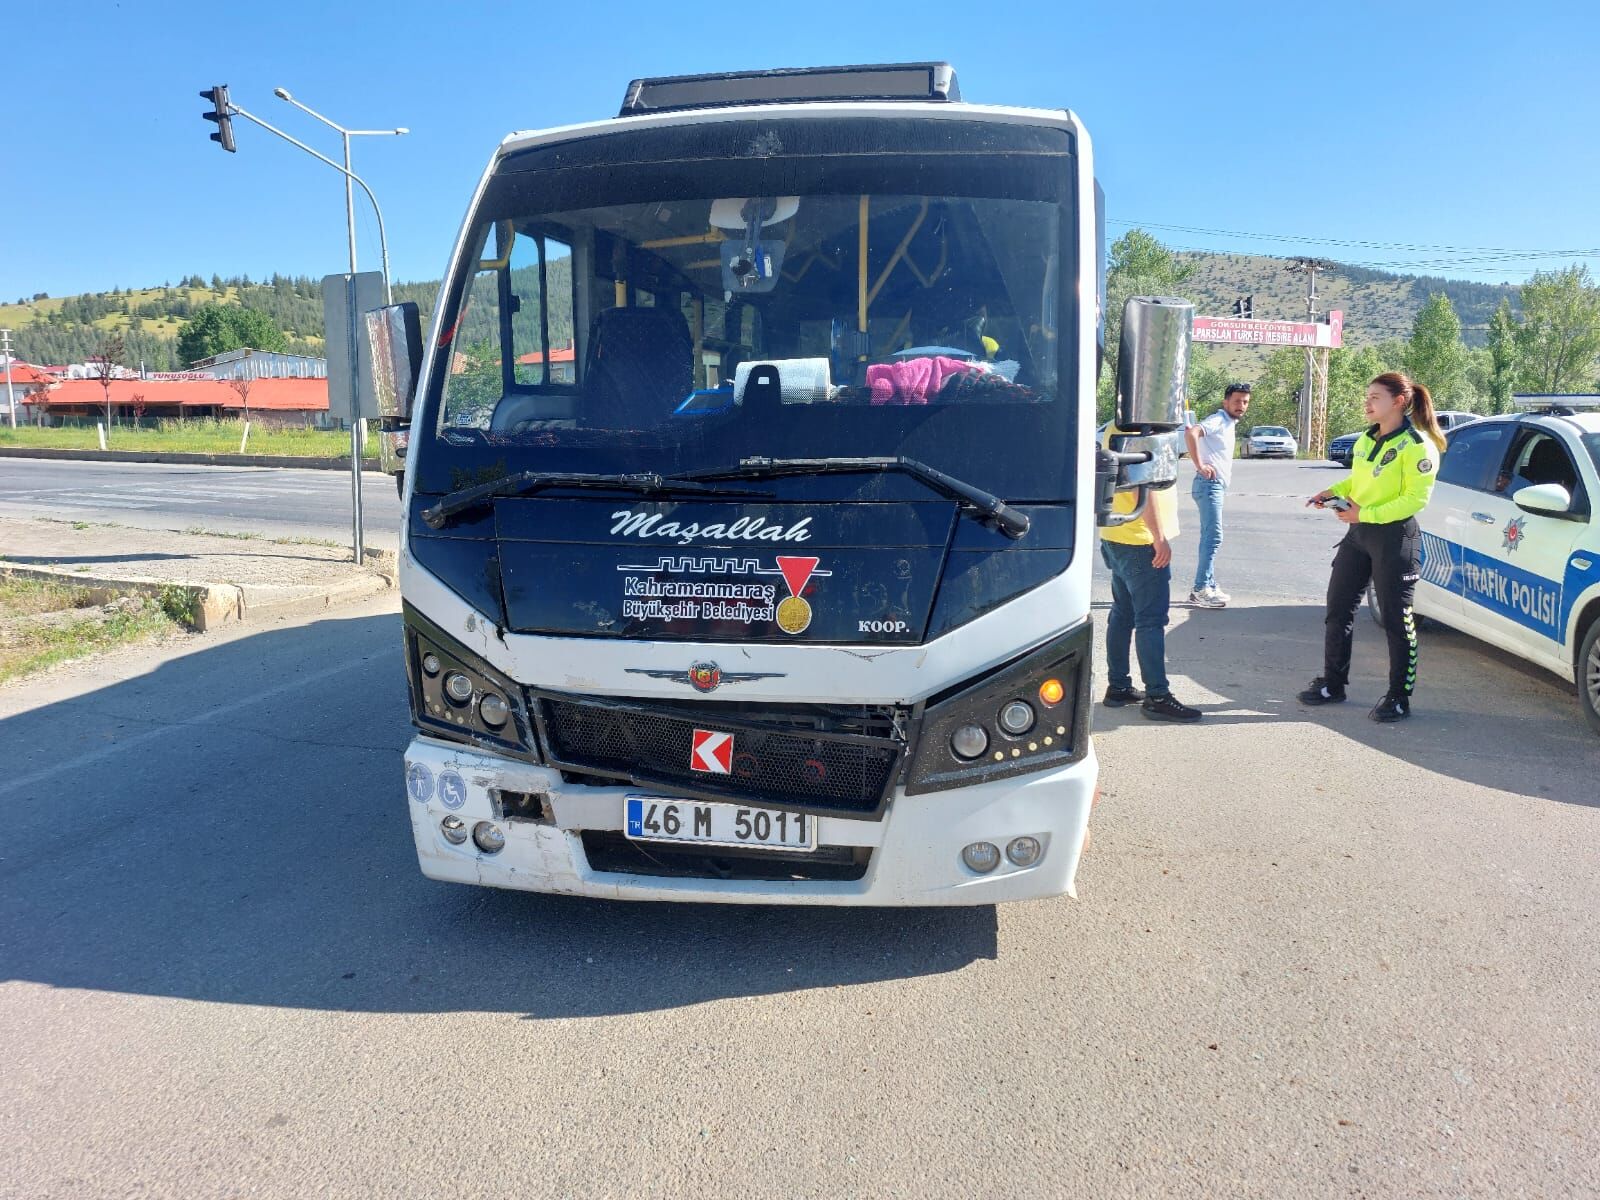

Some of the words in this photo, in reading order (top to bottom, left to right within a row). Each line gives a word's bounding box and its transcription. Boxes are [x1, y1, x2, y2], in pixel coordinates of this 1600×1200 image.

[1191, 327, 1232, 341] LPARSLAN
[1232, 329, 1264, 343] TÜRKEŞ
[1293, 333, 1315, 345] ALANI
[609, 510, 813, 545] Maşallah
[624, 577, 775, 604] Kahramanmaraş
[1465, 562, 1509, 605] TRAFİK
[1511, 580, 1556, 627] POLİSİ
[623, 600, 700, 622] Büyükşehir
[702, 601, 775, 624] Belediyesi
[857, 620, 910, 633] KOOP.
[629, 820, 641, 829] TR
[643, 804, 681, 835] 46
[694, 806, 712, 837] M
[734, 809, 806, 844] 5011
